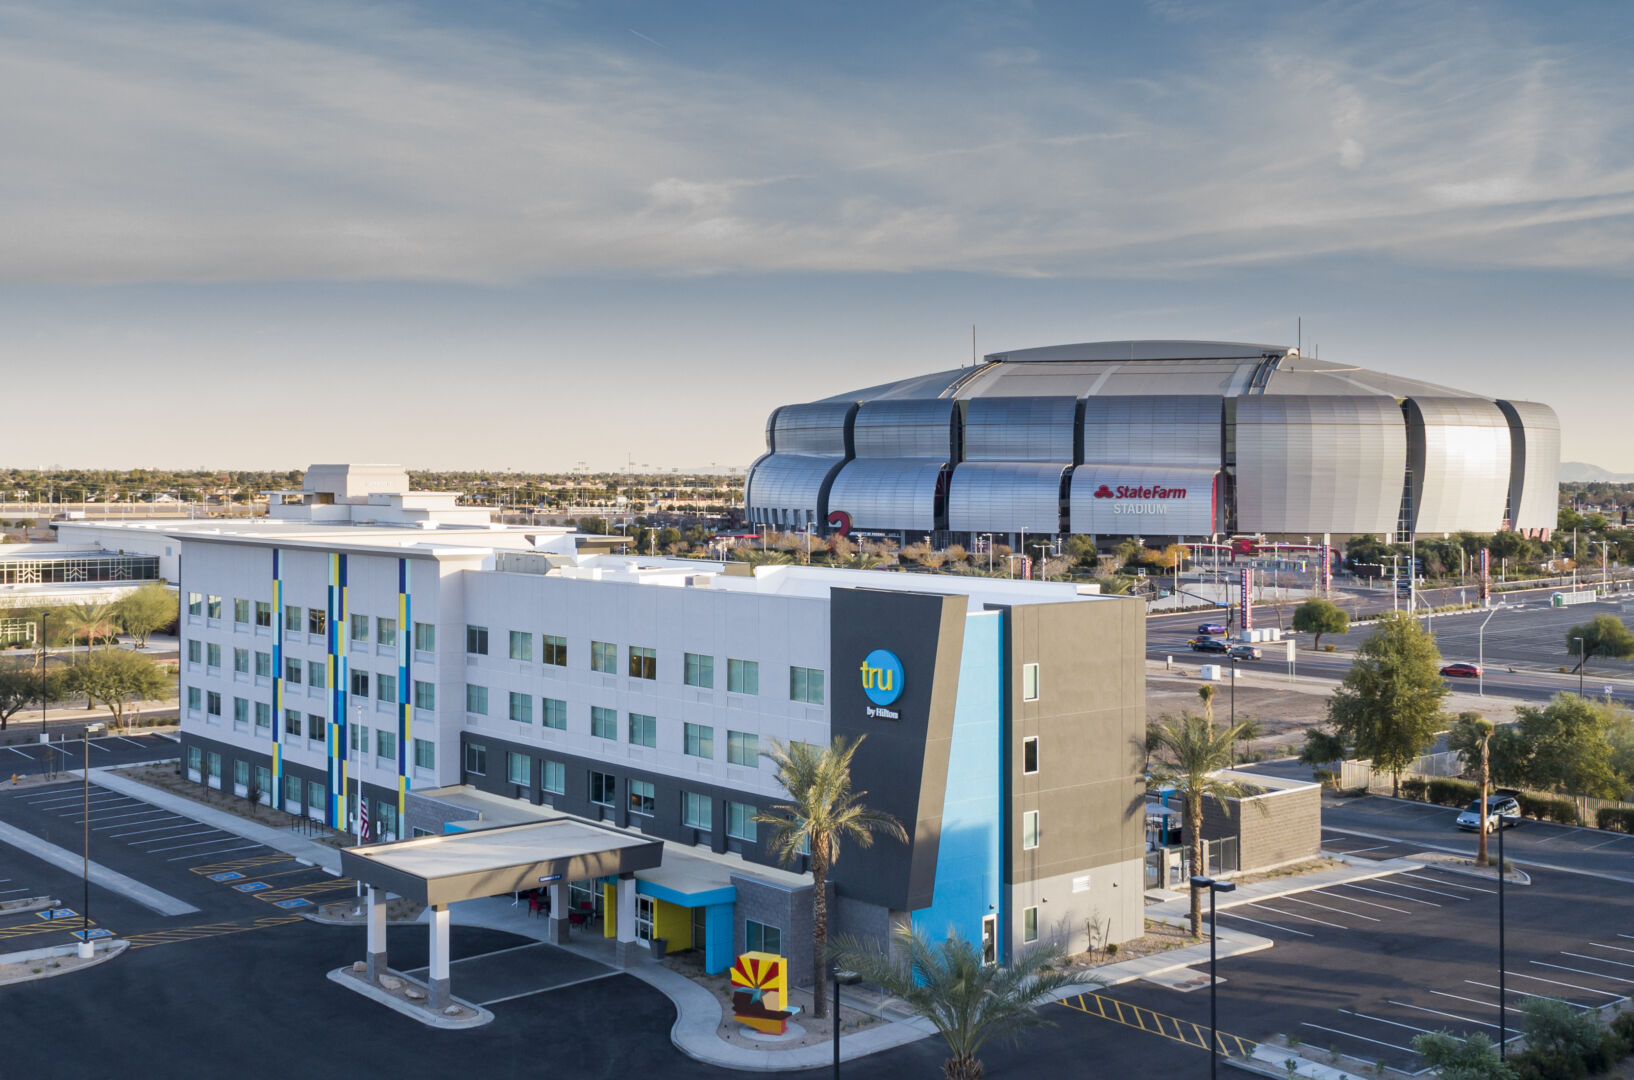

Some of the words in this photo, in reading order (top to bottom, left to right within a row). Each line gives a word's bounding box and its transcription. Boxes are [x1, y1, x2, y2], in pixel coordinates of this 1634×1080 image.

[1113, 503, 1168, 515] STADIUM
[860, 661, 893, 691] tru
[866, 706, 876, 718] by
[876, 707, 899, 719] Hilton
